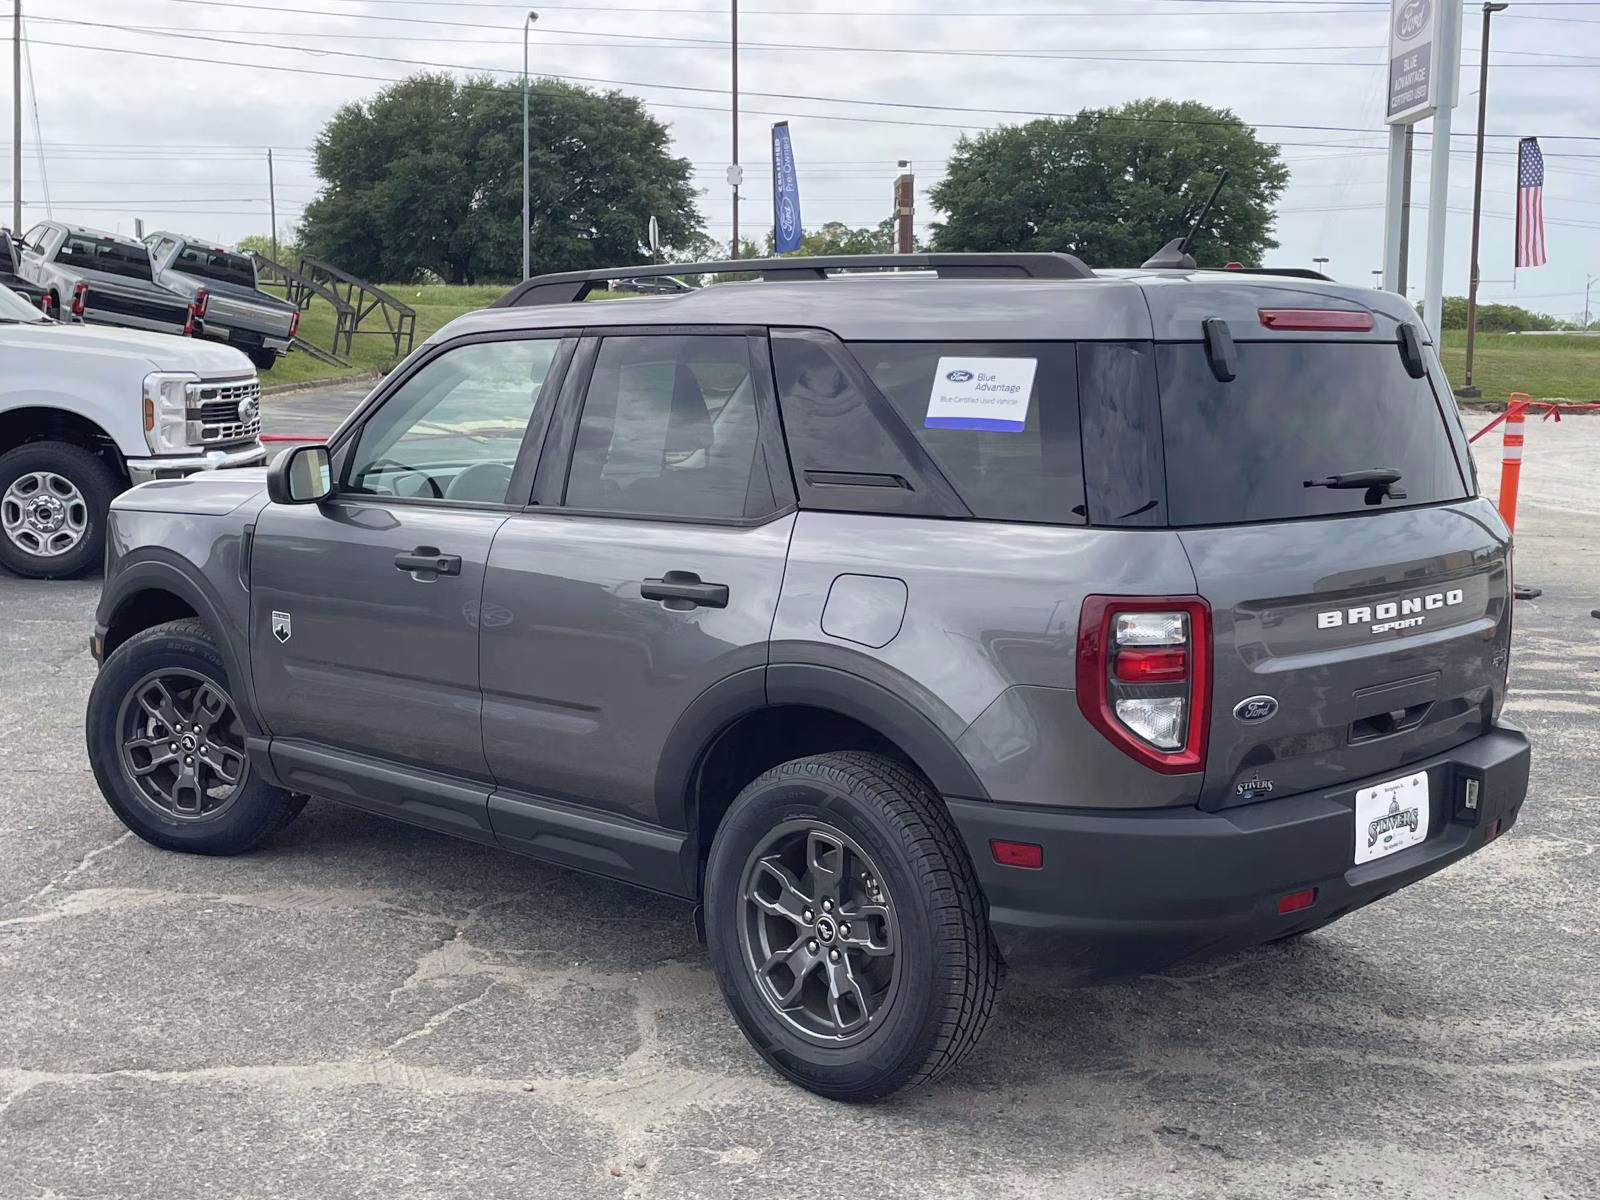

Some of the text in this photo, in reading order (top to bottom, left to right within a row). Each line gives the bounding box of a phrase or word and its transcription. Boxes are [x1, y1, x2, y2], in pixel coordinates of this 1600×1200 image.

[1401, 1, 1425, 35] Ford
[1403, 53, 1418, 72] BLUE
[1394, 67, 1426, 91] ADVANTAGE
[977, 373, 996, 382] Blue
[975, 383, 1021, 393] Advantage
[1317, 589, 1463, 629] BRONCO
[1372, 616, 1425, 634] SPORT
[1245, 702, 1270, 718] Ford
[1236, 780, 1274, 795] STIVERS
[1368, 808, 1418, 848] STIVERS
